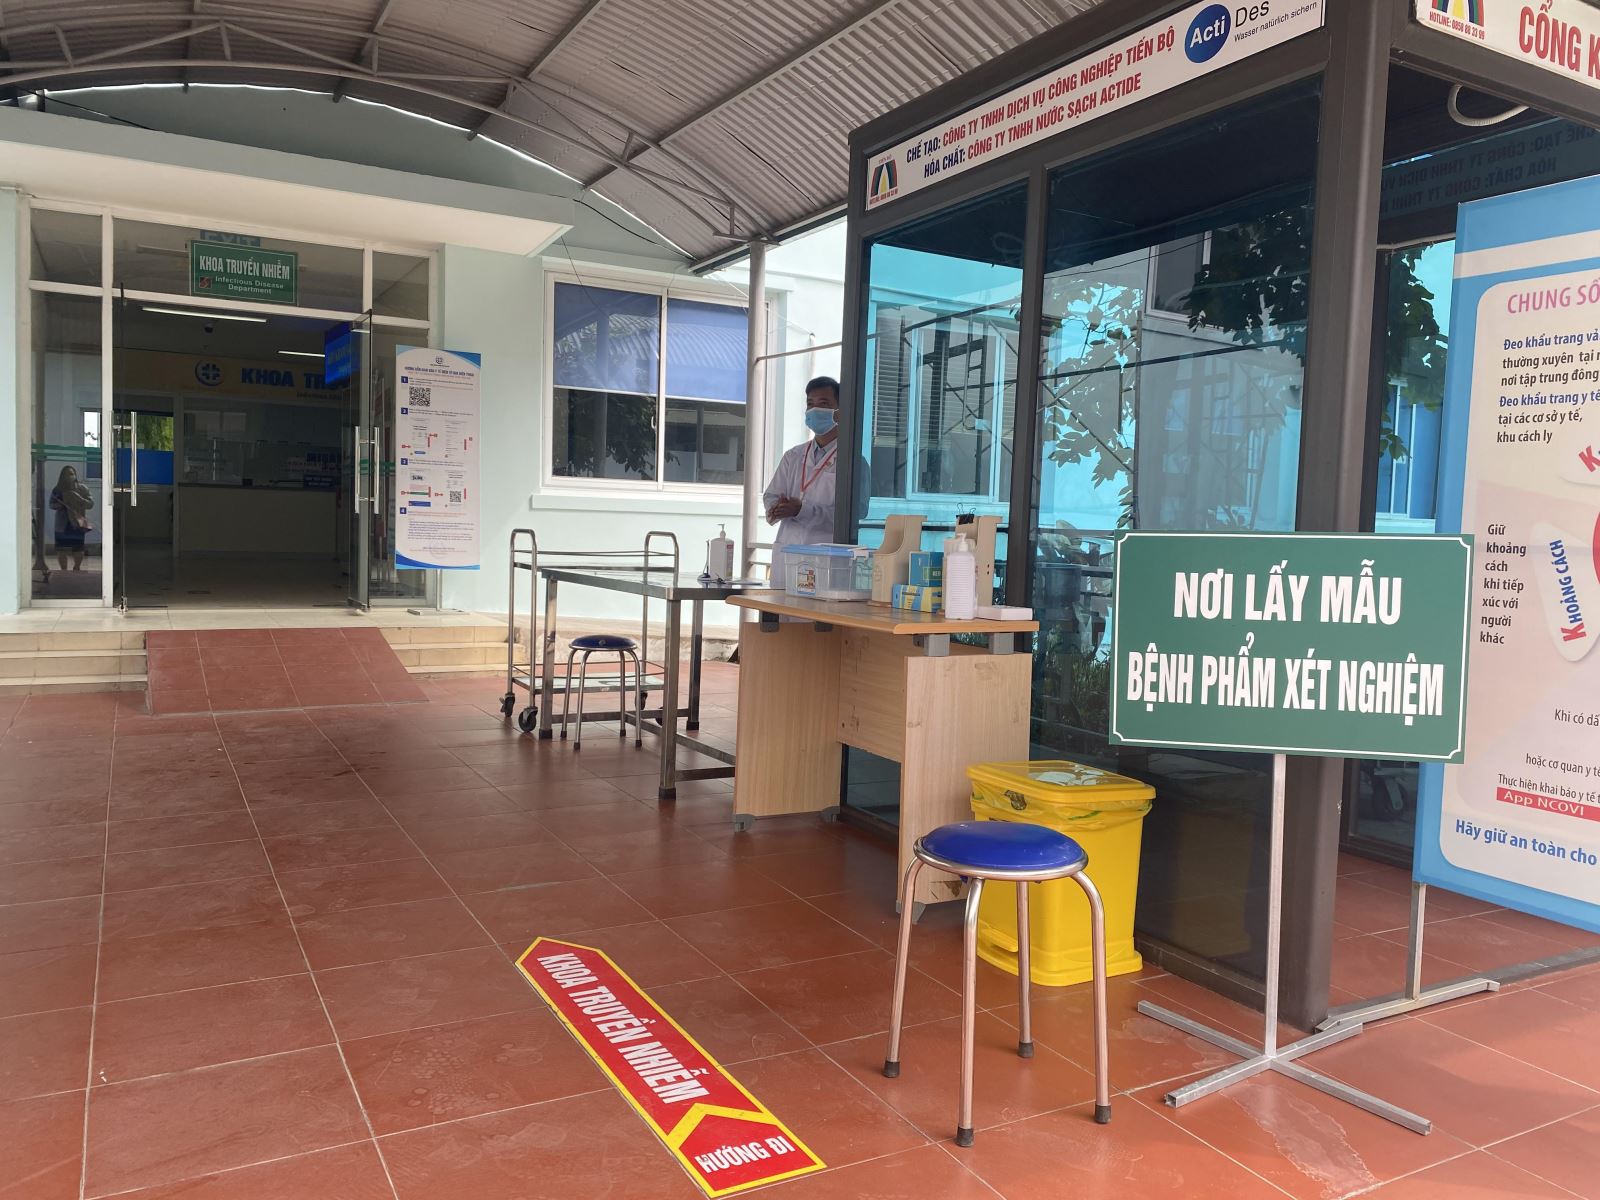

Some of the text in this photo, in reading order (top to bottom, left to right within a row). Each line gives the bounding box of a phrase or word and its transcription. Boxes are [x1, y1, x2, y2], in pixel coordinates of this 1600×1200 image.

[1190, 0, 1270, 48] Acti Des
[1234, 2, 1318, 43] Wasser natürlich sichern
[1429, 11, 1452, 28] HOTLINE:
[906, 25, 1175, 163] CHẾ TẠO: CÔNG TY TNHH DỊCH VỤ CÔNG NGHIỆP TIẾN BỘ
[924, 72, 1142, 178] HÓA CHẤT: CÔNG TY TNHH NƯỚC SẠCH ACTIDE
[200, 255, 290, 280] KHOA TRUYỀN NHIỄM
[215, 276, 284, 289] Infectious Disease
[228, 283, 272, 295] Department
[1507, 287, 1571, 314] CHUNG
[1504, 338, 1523, 350] Đeo
[1525, 333, 1551, 349] khẩu
[1553, 332, 1584, 346] trang
[1502, 355, 1540, 369] thường
[1542, 351, 1574, 368] xuyên
[1579, 349, 1594, 365] tại
[241, 367, 295, 387] KHOA
[1501, 368, 1600, 388] nơi tập trung đông
[1499, 395, 1519, 407] Đeo
[1521, 391, 1547, 405] khẩu
[1549, 391, 1579, 405] trang
[1581, 392, 1588, 405] y
[1498, 407, 1583, 428] tại các cơ sở y tế,
[1497, 429, 1553, 444] khu cách ly
[1488, 523, 1506, 535] Giữ
[1486, 542, 1527, 557] khoảng
[1485, 560, 1508, 572] cách
[1173, 558, 1402, 626] NƠI LẤY MẪU
[1483, 576, 1524, 593] khi tiếp
[1549, 539, 1587, 642] KHOẢNG CÁCH
[1482, 596, 1519, 609] xúc với
[1481, 614, 1512, 628] người
[1480, 631, 1505, 644] khác
[1127, 631, 1444, 726] BỆNH PHẨM XÉT NGHIỆM
[1554, 708, 1571, 722] Khi
[1573, 712, 1585, 724] có
[1526, 753, 1547, 769] hoặc
[1548, 760, 1559, 769] cơ
[1560, 762, 1583, 774] quan
[1585, 766, 1592, 778] y
[1498, 773, 1518, 788] Thực
[1519, 776, 1538, 792] hiện
[1540, 781, 1558, 795] khai
[1560, 785, 1577, 799] báo
[1578, 791, 1585, 803] y
[1586, 791, 1597, 803] tế
[1504, 790, 1533, 806] App
[1537, 796, 1584, 816] NCOVI
[1456, 819, 1597, 866] Hãy giữ an toàn cho
[536, 952, 710, 1104] KHOA TRUYỀN NHIỄM
[694, 1136, 796, 1174] HƯỚNG ĐI
